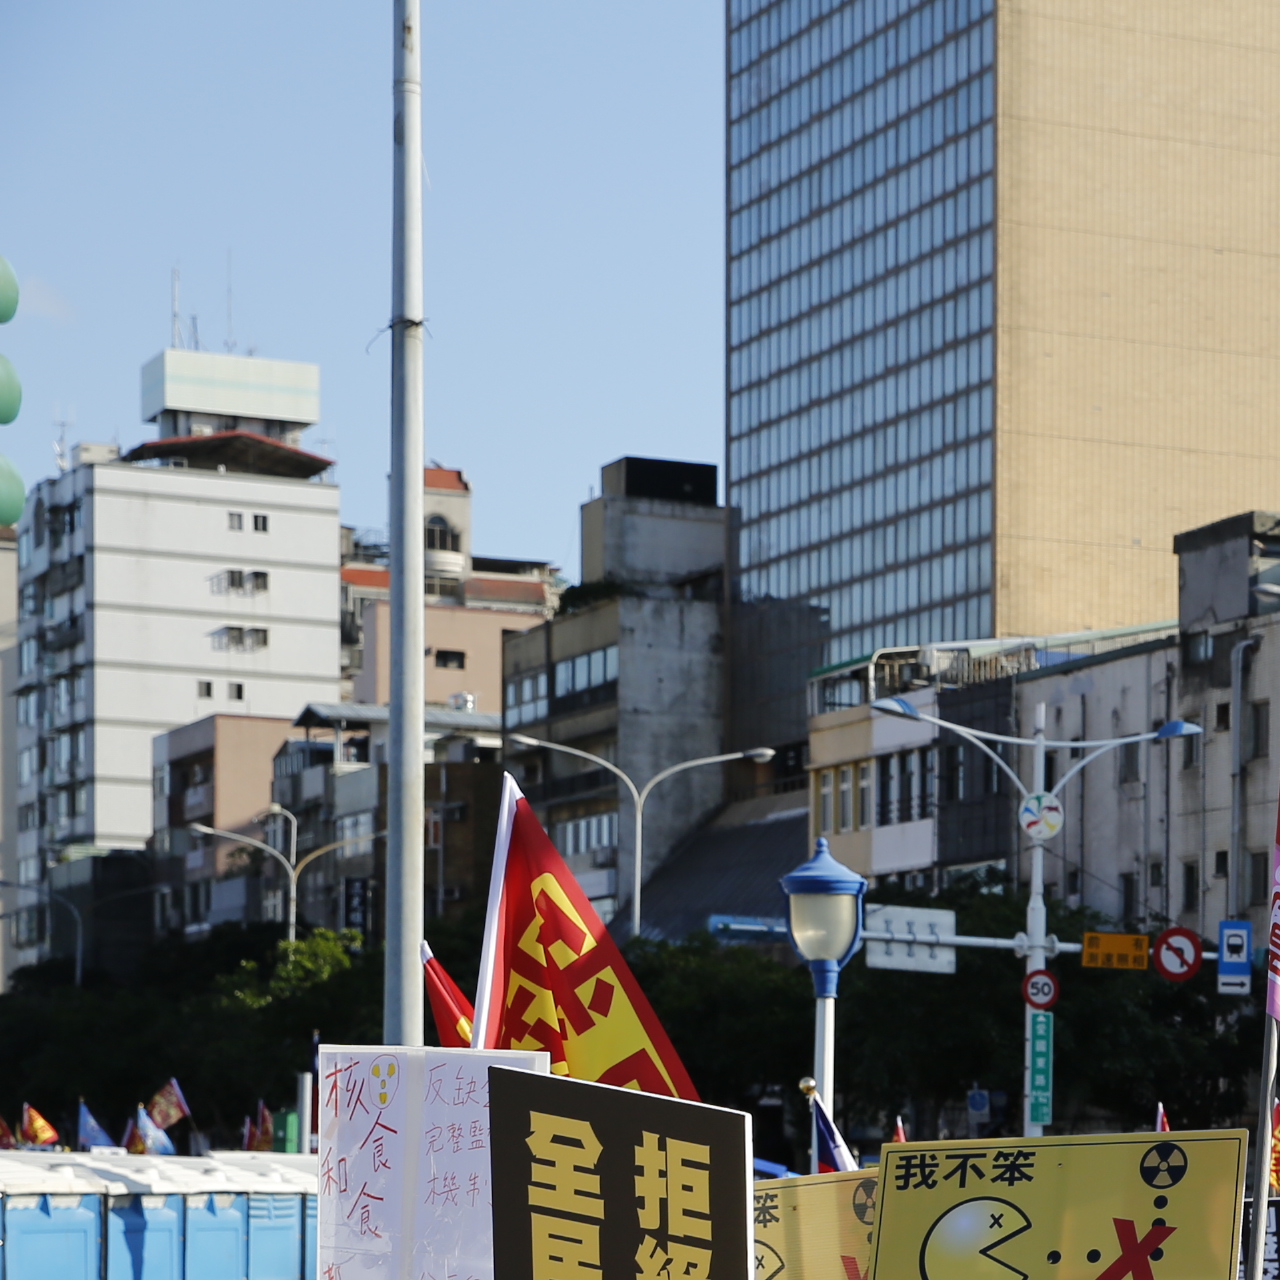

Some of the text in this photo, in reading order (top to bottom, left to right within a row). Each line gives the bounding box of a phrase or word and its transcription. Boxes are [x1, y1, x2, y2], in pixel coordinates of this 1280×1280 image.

[1030, 981, 1052, 998] 50
[424, 1122, 492, 1156] 完整監
[895, 1151, 1035, 1190] 我不笨
